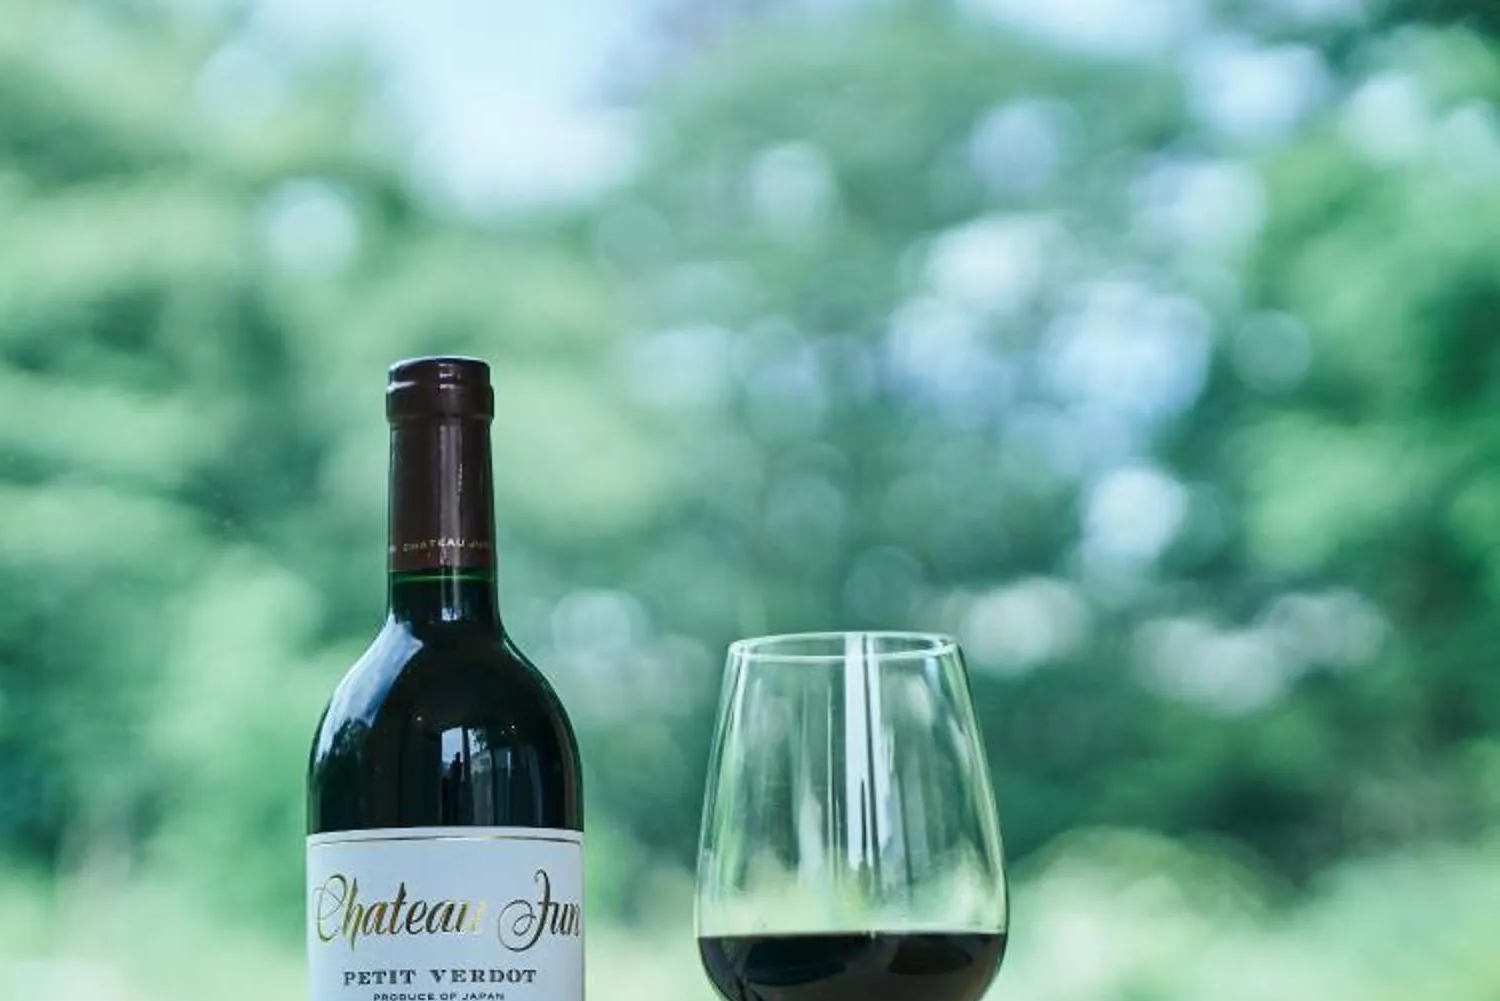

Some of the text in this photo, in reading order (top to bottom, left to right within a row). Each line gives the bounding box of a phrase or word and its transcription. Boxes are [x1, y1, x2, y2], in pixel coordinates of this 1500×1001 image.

[312, 867, 581, 951] Chateau Jun
[343, 968, 537, 987] PETIT VERDOT
[373, 991, 505, 1001] PRODUCE OF JAPAN
